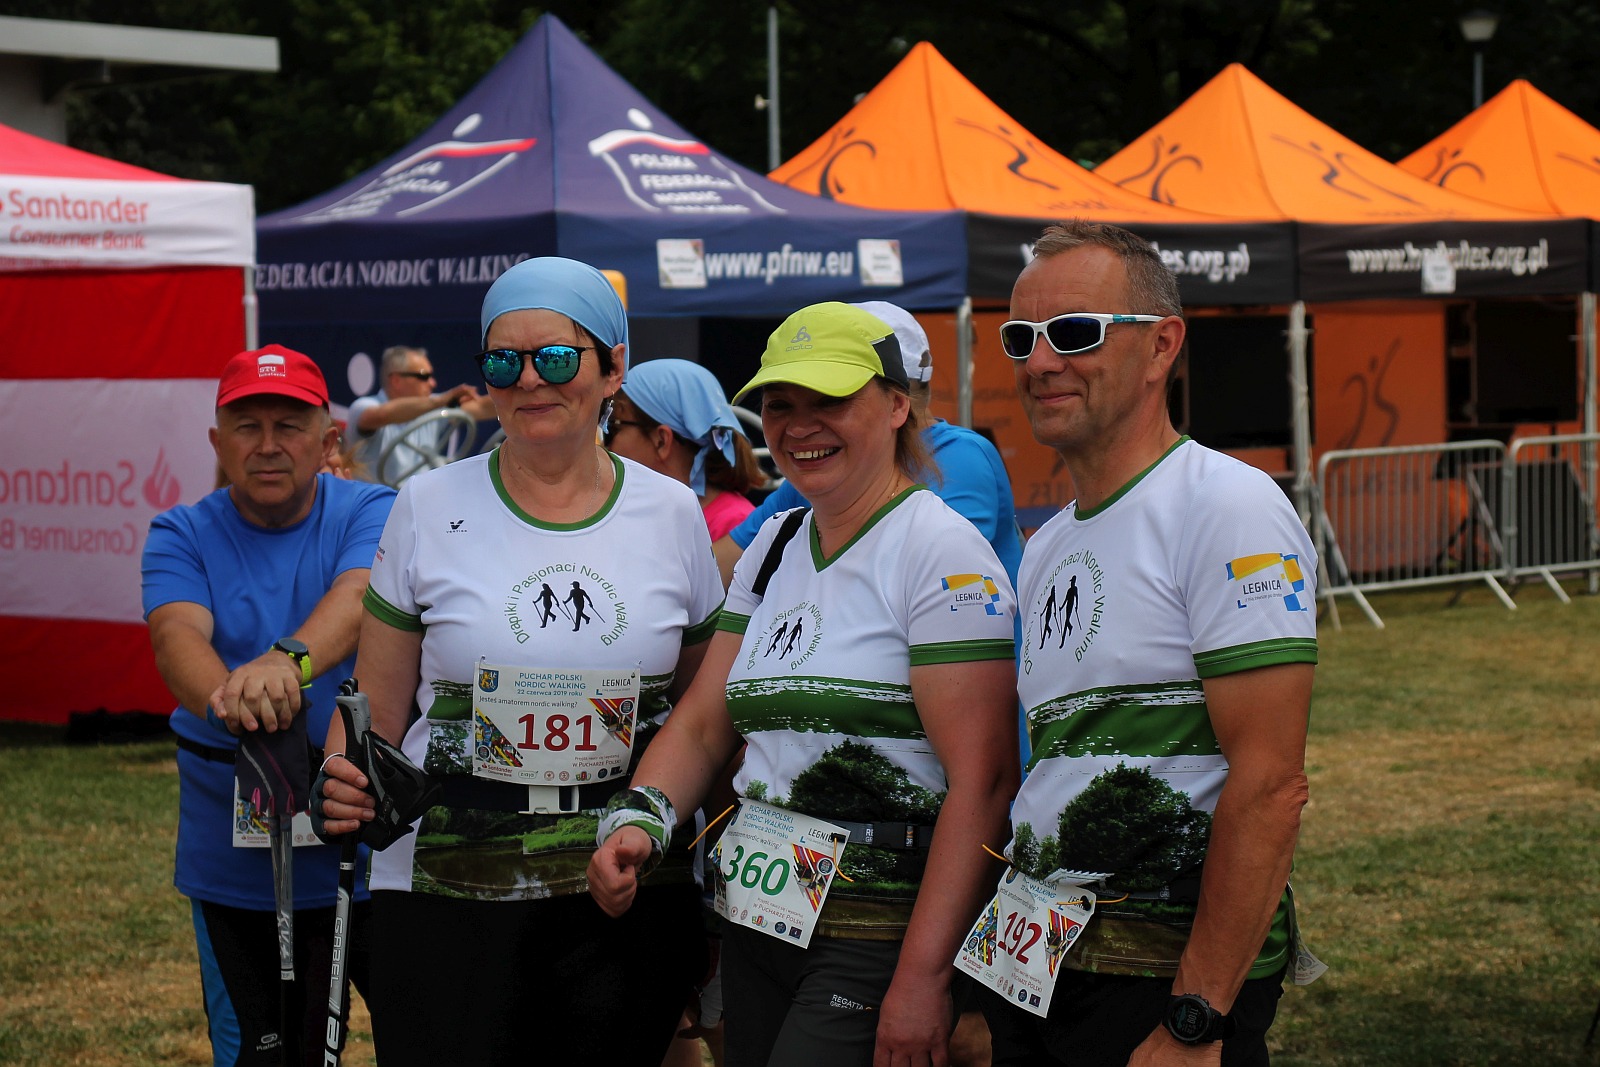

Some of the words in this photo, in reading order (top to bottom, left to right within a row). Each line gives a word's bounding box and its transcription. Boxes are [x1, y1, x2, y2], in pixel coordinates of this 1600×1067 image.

[628, 153, 698, 170] POLSKA
[9, 189, 149, 223] Santander
[9, 225, 97, 247] Consumer
[102, 229, 147, 250] Bank
[357, 258, 434, 287] NORDIC
[705, 243, 853, 285] www.pfnw.eu
[512, 562, 576, 594] Pasjonaci
[580, 565, 618, 600] Nordic
[1082, 550, 1105, 594] Nordic
[956, 592, 984, 602] LEGNICA
[1243, 580, 1282, 595] LEGNICA
[504, 603, 530, 645] Drapiki
[600, 602, 629, 646] Walking
[808, 604, 824, 632] Nordic
[1075, 595, 1106, 662] Walking
[790, 632, 823, 670] Walking
[520, 672, 552, 680] PUCHAR
[602, 678, 631, 686] LEGNICA
[552, 700, 578, 708] walking?
[516, 713, 598, 752] 181
[488, 764, 512, 774] Santander
[744, 813, 764, 824] NORDIC
[764, 818, 794, 833] WALKING
[748, 804, 770, 816] PUCHAR
[771, 810, 794, 824] POLSKI
[764, 827, 776, 836] 2019
[776, 831, 789, 840] roku
[808, 828, 833, 842] LEGNIC
[724, 844, 790, 896] 360
[1030, 884, 1057, 898] WALKING
[997, 911, 1043, 965] 192
[331, 917, 343, 988] GABEL
[832, 994, 864, 1010] REGATTA
